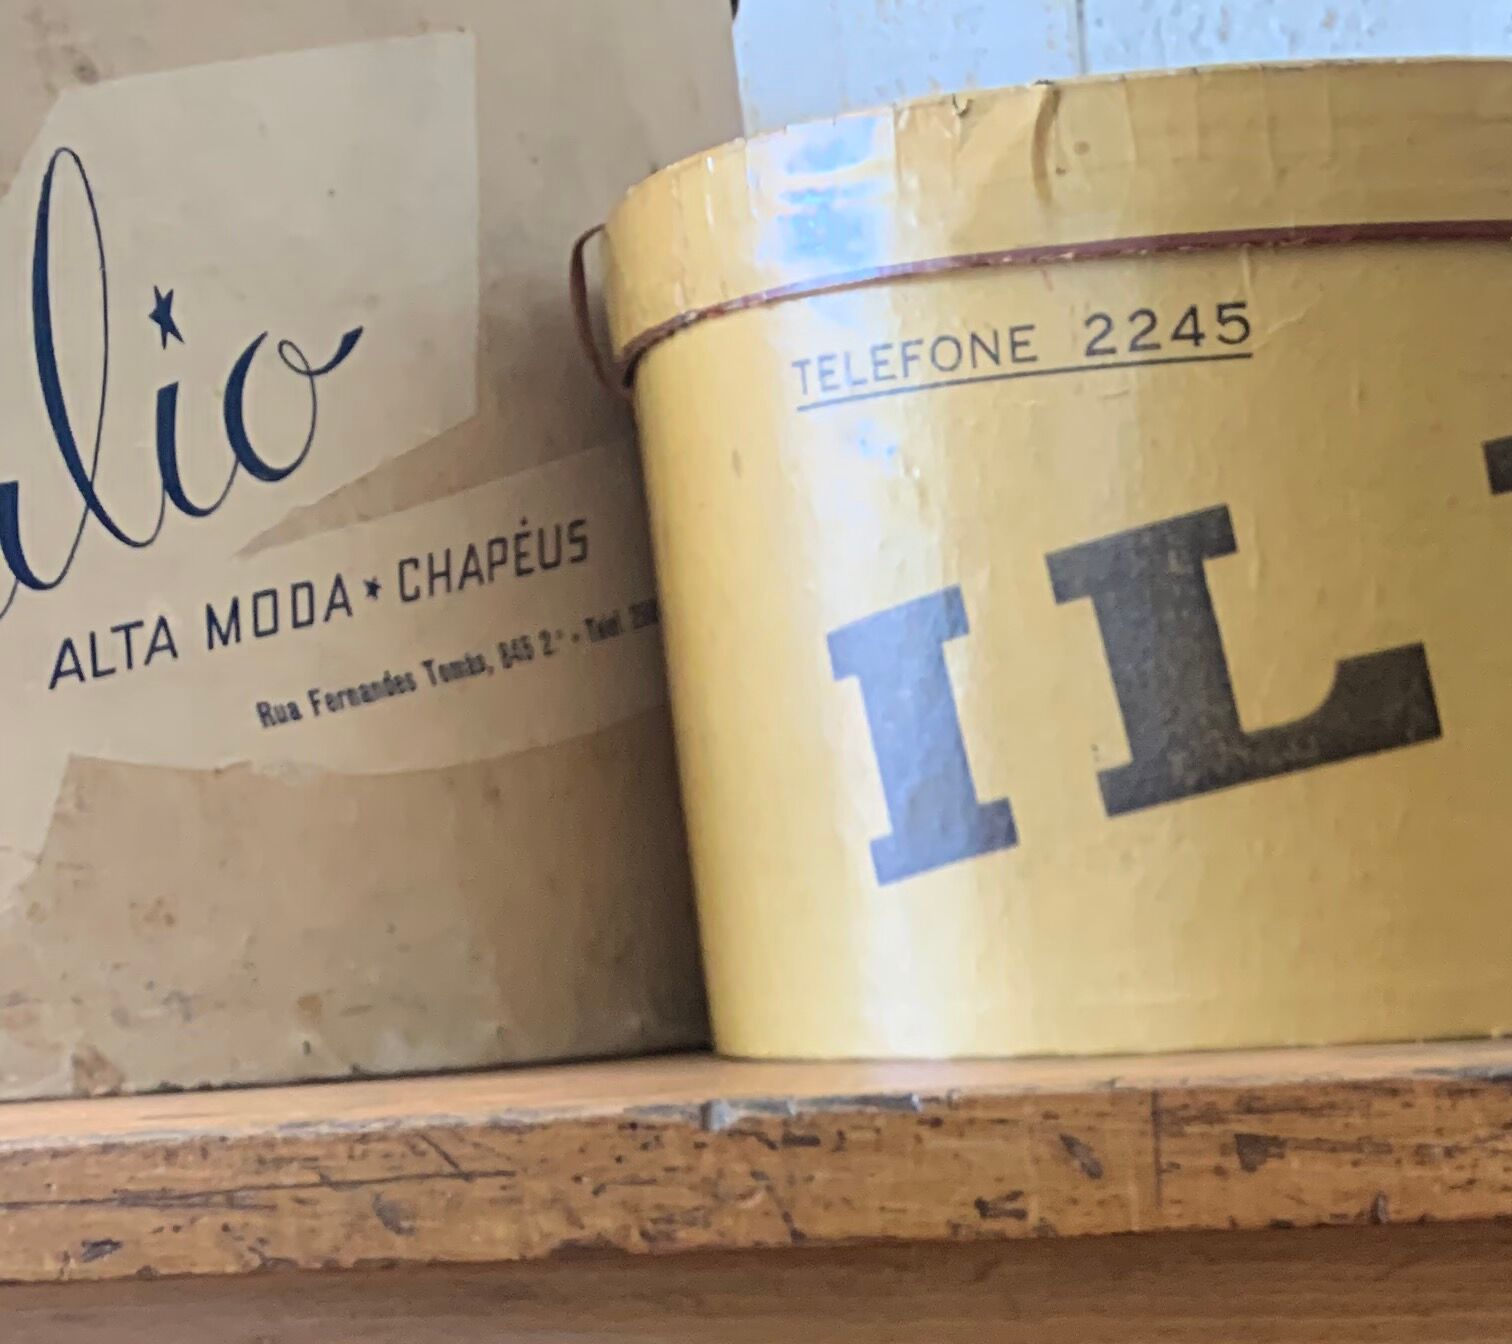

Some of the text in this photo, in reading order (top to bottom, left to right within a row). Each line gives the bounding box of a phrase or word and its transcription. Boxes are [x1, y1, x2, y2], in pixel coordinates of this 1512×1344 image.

[791, 302, 1252, 396] TELEFONE 2245
[48, 517, 589, 690] ALTA MODA CHAPÉUS
[256, 700, 303, 729] Rua
[307, 669, 418, 718] Fernandes
